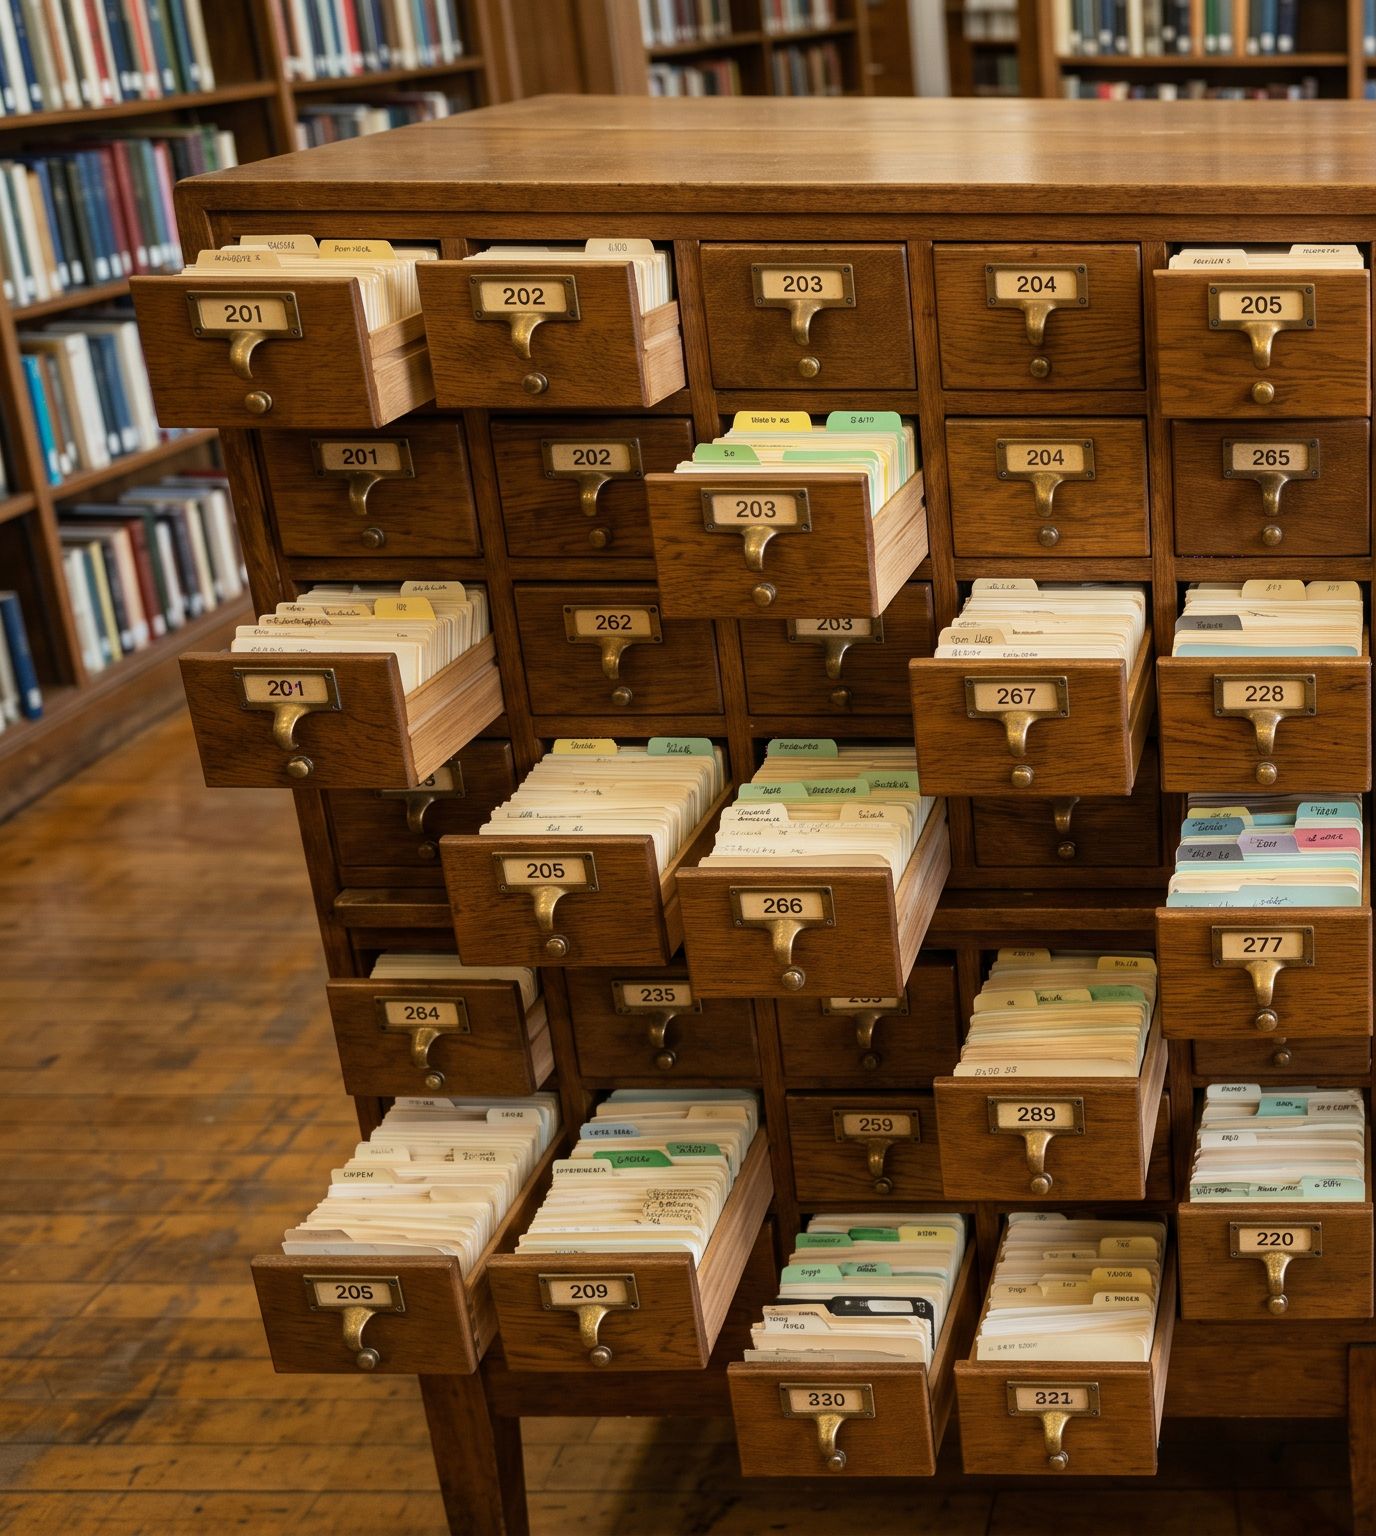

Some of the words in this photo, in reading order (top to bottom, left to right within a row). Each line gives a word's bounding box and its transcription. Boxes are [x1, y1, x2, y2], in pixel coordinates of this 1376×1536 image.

[782, 275, 823, 293] 203
[1016, 275, 1057, 293] 204
[503, 287, 546, 306] 202
[1240, 295, 1282, 314] 205
[224, 304, 263, 323] 201
[341, 448, 378, 465] 201
[572, 448, 612, 466] 202
[1026, 448, 1065, 466] 204
[1252, 449, 1290, 466] 265
[735, 500, 777, 519] 203
[595, 614, 633, 631] 262
[267, 679, 304, 697] 201
[997, 687, 1036, 705] 267
[1245, 685, 1284, 702] 228
[526, 862, 565, 879] 205
[763, 897, 803, 914] 266
[1243, 936, 1283, 953] 277
[640, 987, 676, 1003] 235
[404, 1005, 441, 1021] 264
[1017, 1106, 1056, 1122] 289
[859, 1117, 894, 1132] 259
[1256, 1231, 1294, 1247] 220
[335, 1284, 374, 1300] 205
[569, 1283, 608, 1299] 209
